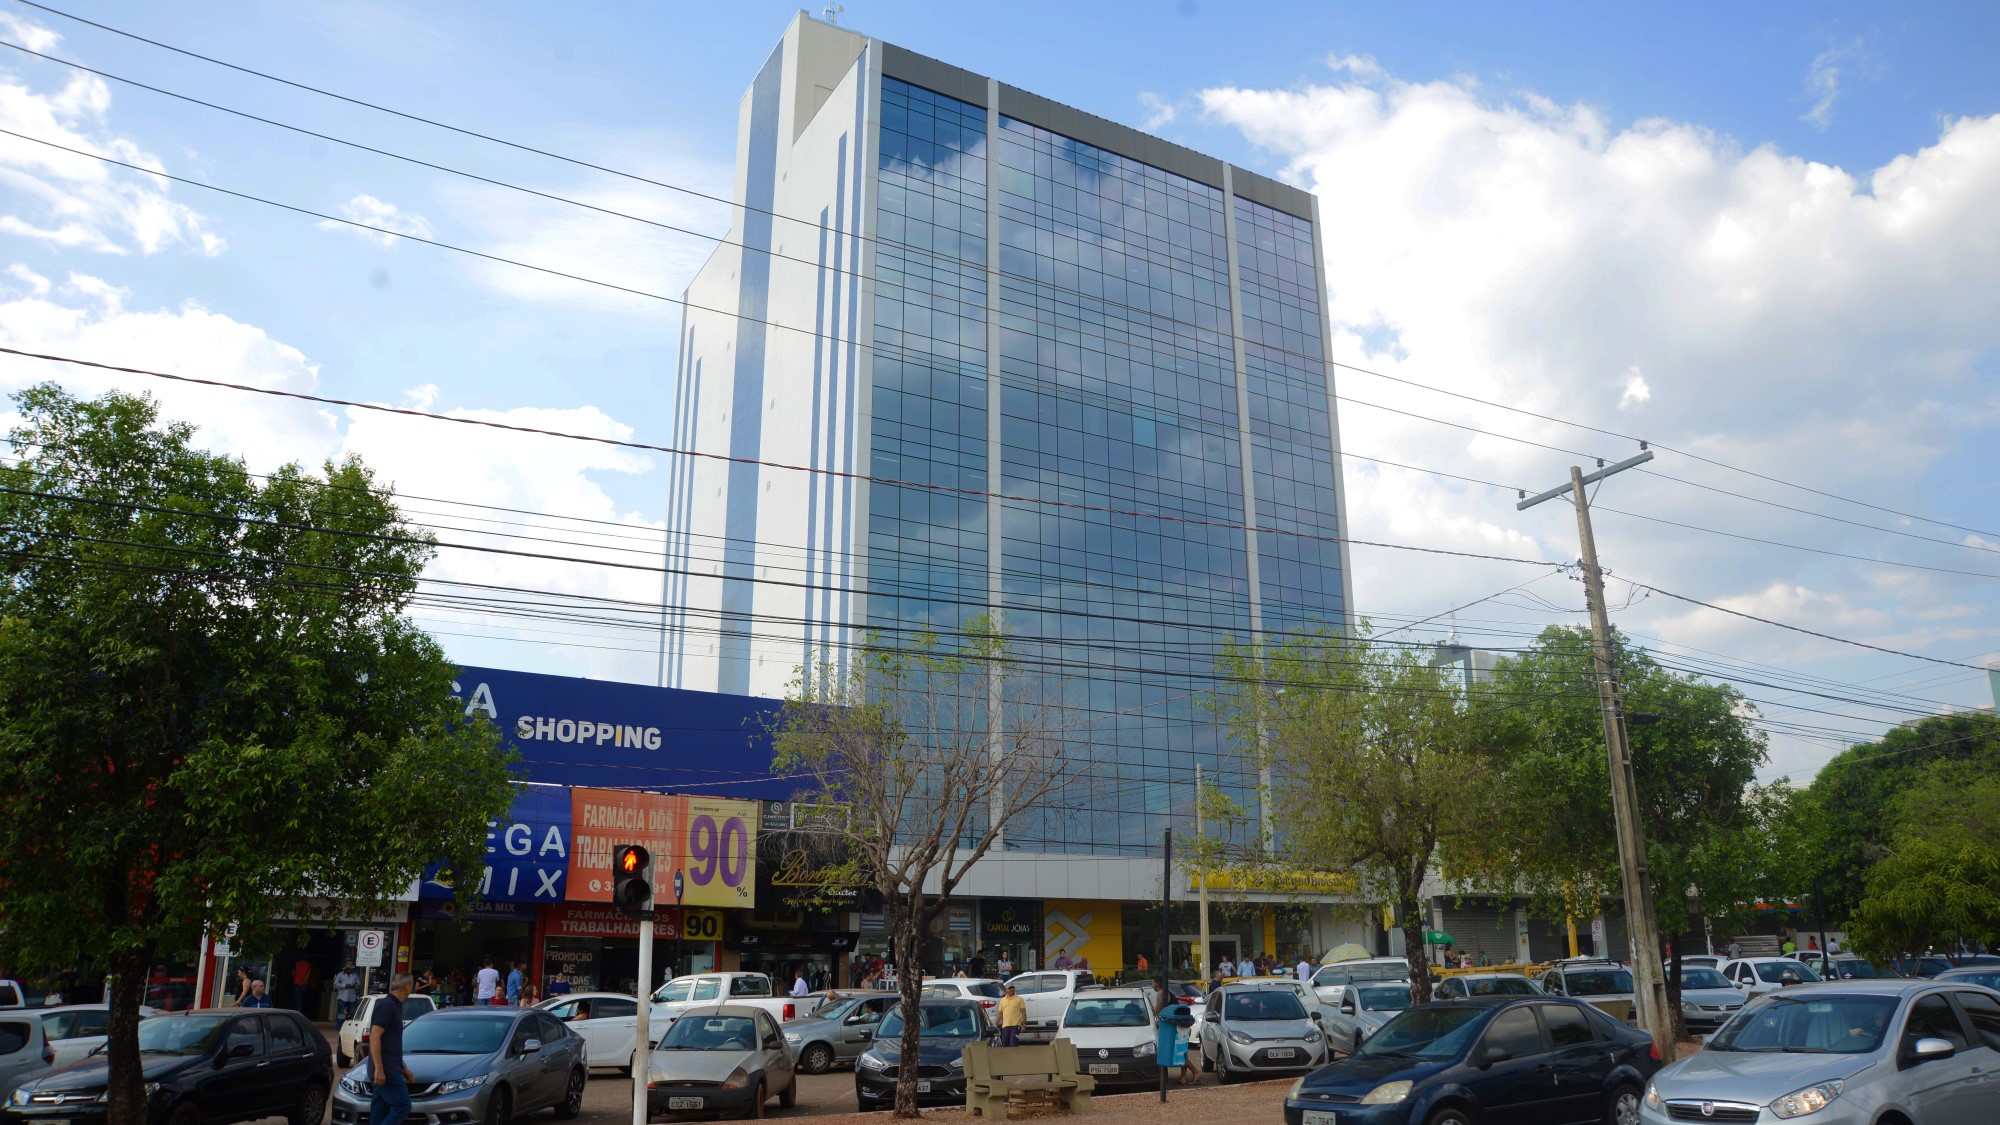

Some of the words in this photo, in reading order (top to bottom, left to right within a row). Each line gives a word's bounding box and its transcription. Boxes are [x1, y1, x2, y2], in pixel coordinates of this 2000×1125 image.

[517, 716, 662, 750] SHOPPING
[583, 801, 646, 831] FARMÁCIA
[649, 809, 673, 833] DOS
[486, 821, 565, 858] EGA
[576, 835, 672, 873] TRABARES
[689, 815, 748, 887] 90
[468, 902, 492, 912] EGA
[494, 903, 515, 913] MIX
[567, 909, 633, 921] FARMÁC
[654, 912, 670, 923] OS
[561, 920, 675, 936] TRABALHADRES
[686, 914, 718, 938] 90
[987, 923, 1010, 933] CAPITAL
[367, 936, 375, 946] E
[545, 950, 593, 964] PROMOÇÃO
[562, 963, 576, 974] DE
[549, 974, 591, 986] FLDAS
